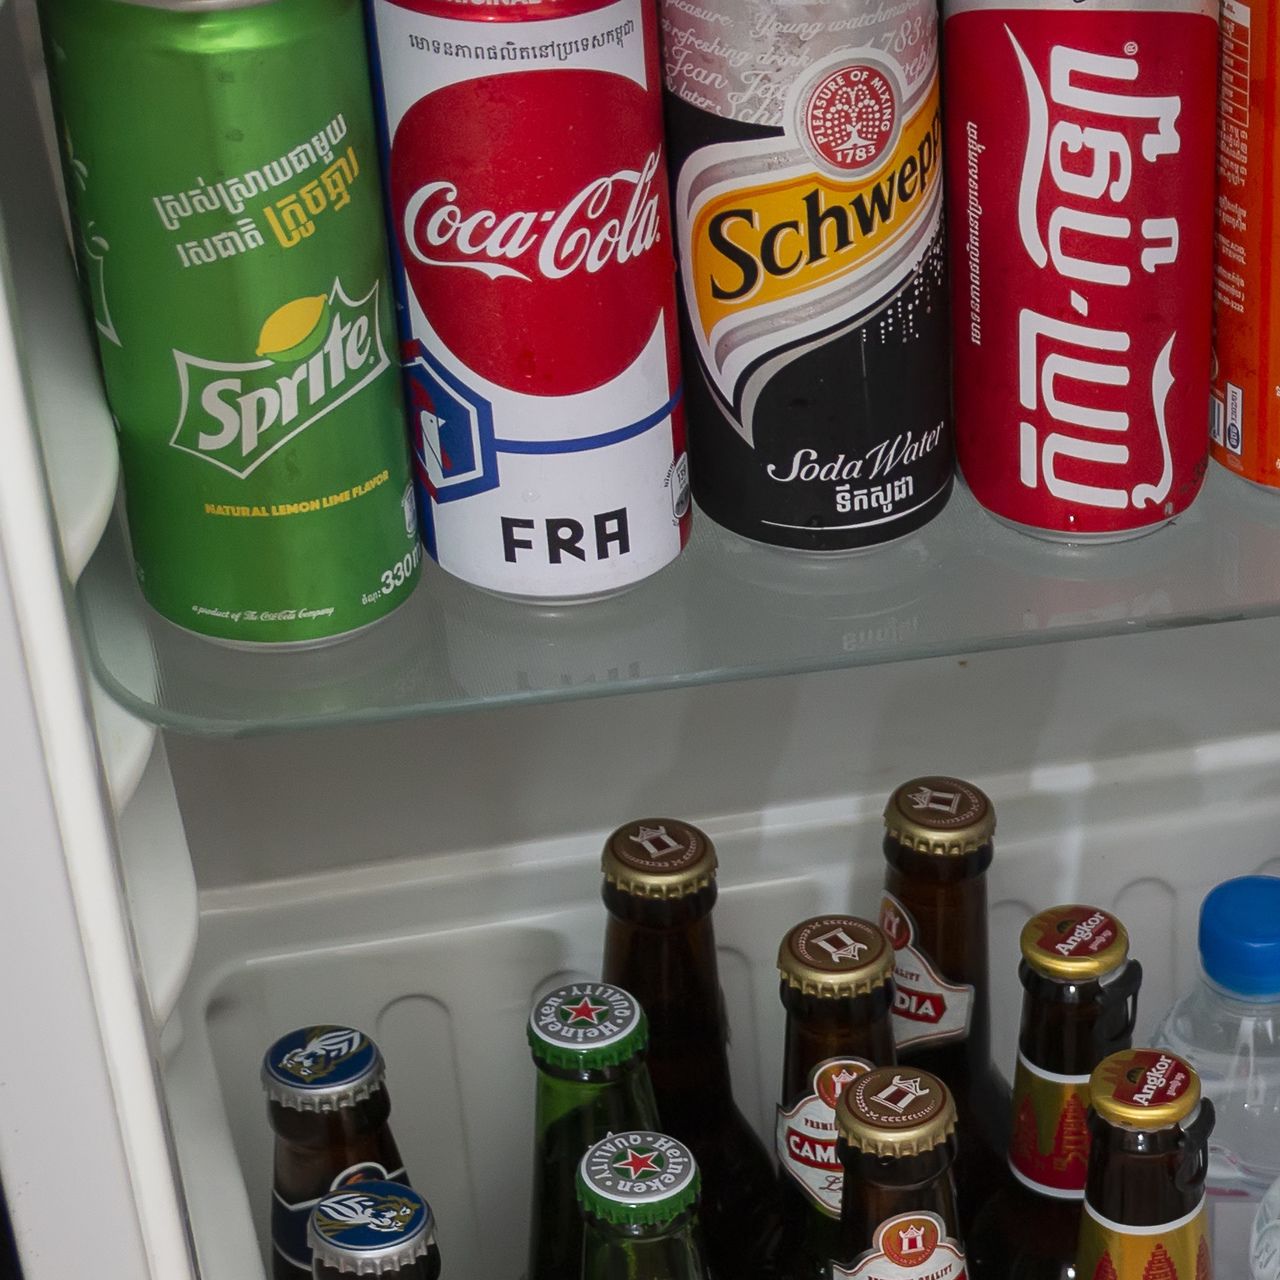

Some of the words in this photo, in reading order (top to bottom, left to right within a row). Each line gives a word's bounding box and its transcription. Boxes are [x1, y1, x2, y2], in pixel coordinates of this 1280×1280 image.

[817, 76, 846, 146] PLEASURE
[850, 71, 869, 83] OF
[870, 78, 892, 132] MIXING
[836, 144, 877, 163] 1783
[404, 143, 663, 284] Coca-Cola
[707, 117, 940, 300] Schwepp
[198, 310, 374, 456] Sprite
[766, 448, 863, 482] Soda
[865, 420, 945, 481] Water
[205, 503, 270, 517] NATURAL
[271, 499, 320, 516] LEMON
[322, 489, 350, 508] LIME
[351, 469, 390, 498] FLAVOR
[501, 506, 632, 565] FRA
[380, 541, 423, 595] 330m
[1056, 911, 1105, 956] Angkor
[538, 996, 620, 1042] Heineken
[571, 985, 631, 1022] QUALITY
[1133, 1055, 1173, 1106] Angkor
[804, 1118, 836, 1130] PREMI
[591, 1134, 642, 1179] QUALITY
[617, 1137, 689, 1198] Heineken
